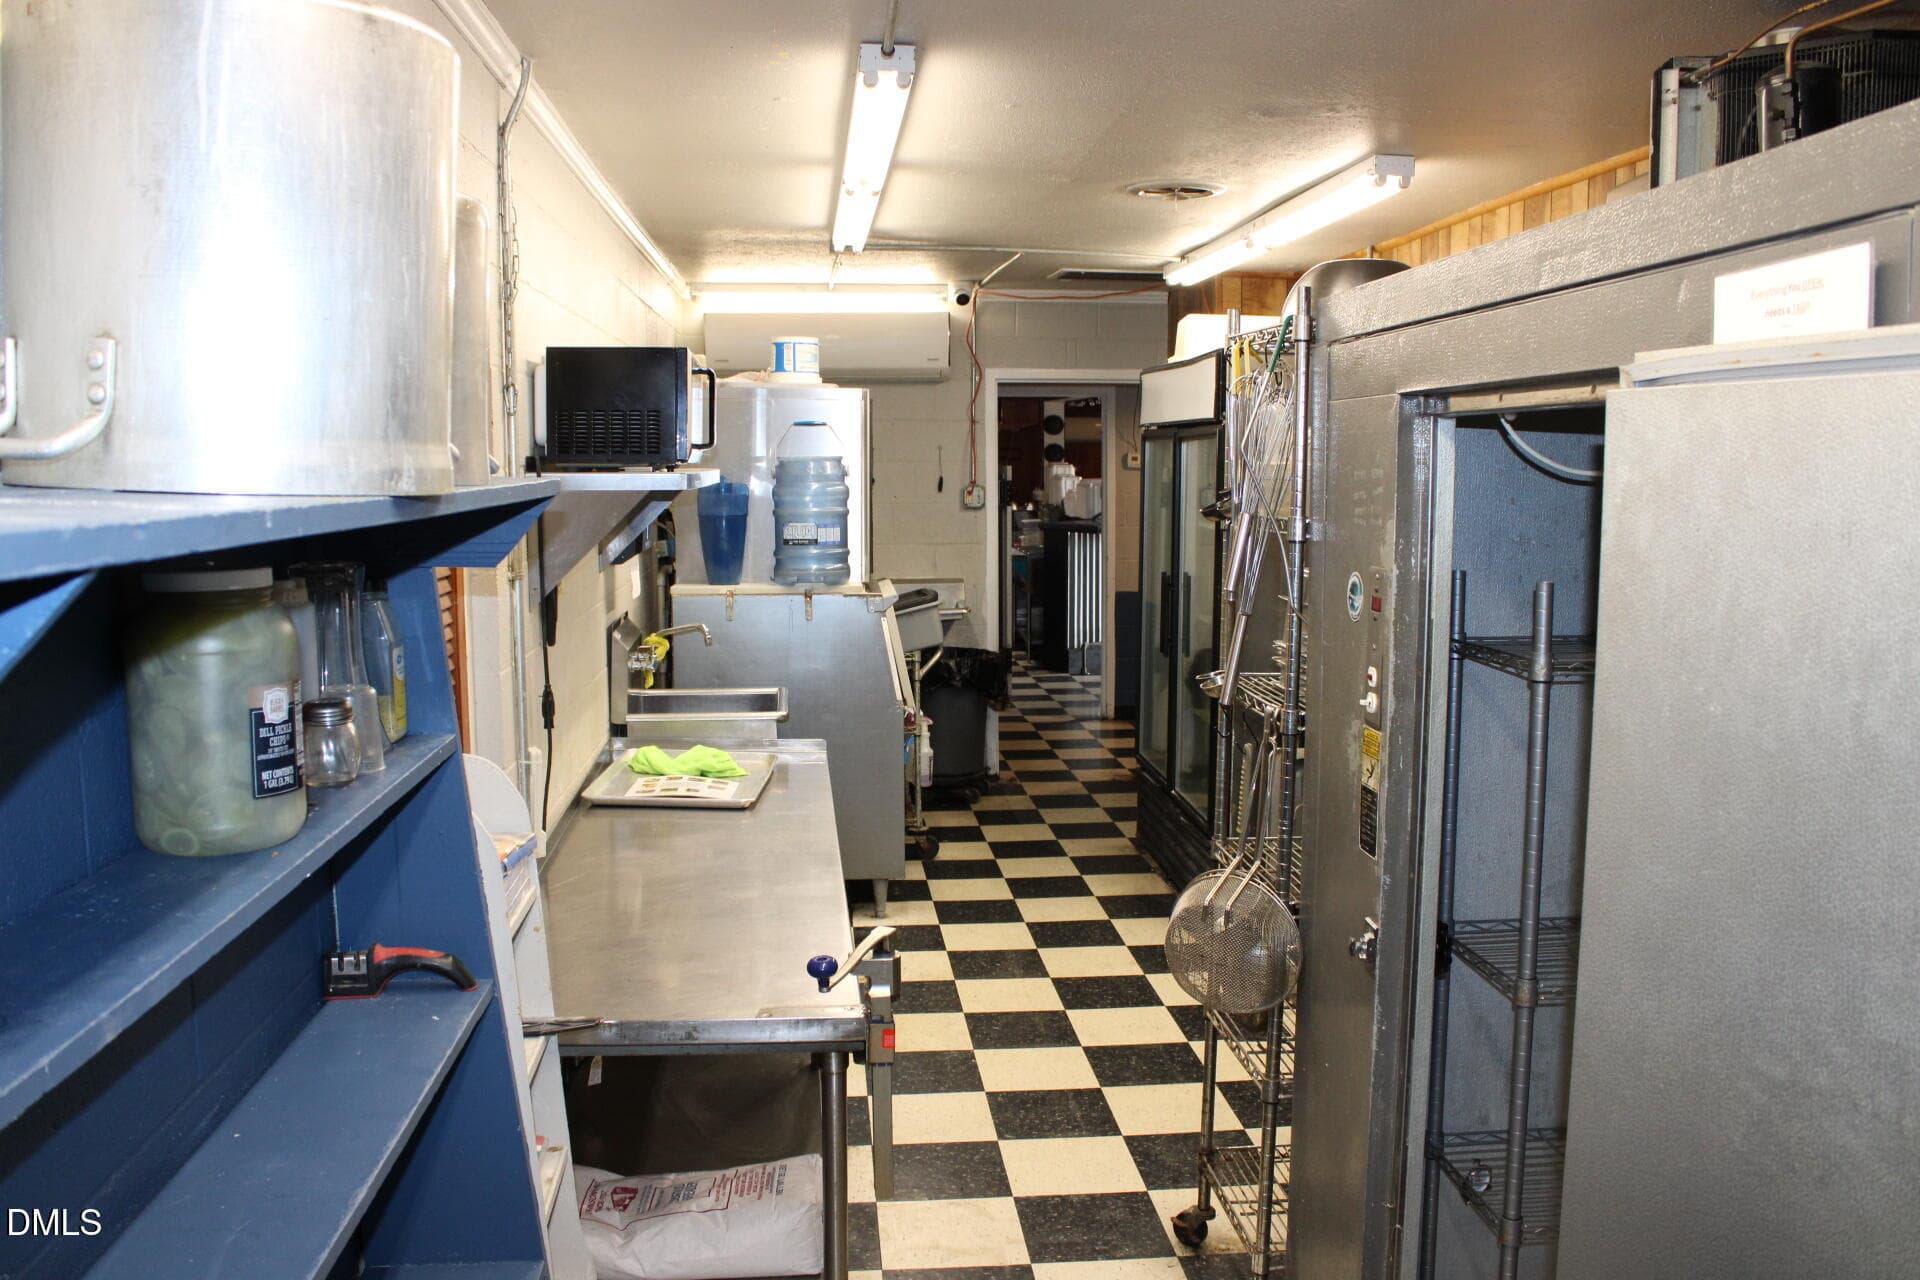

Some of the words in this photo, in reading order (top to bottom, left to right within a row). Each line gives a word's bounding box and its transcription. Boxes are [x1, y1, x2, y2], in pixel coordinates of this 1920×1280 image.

[259, 726, 274, 738] DILL
[275, 722, 293, 735] PICKLE
[261, 769, 273, 781] NET
[273, 765, 294, 778] CONTENTS
